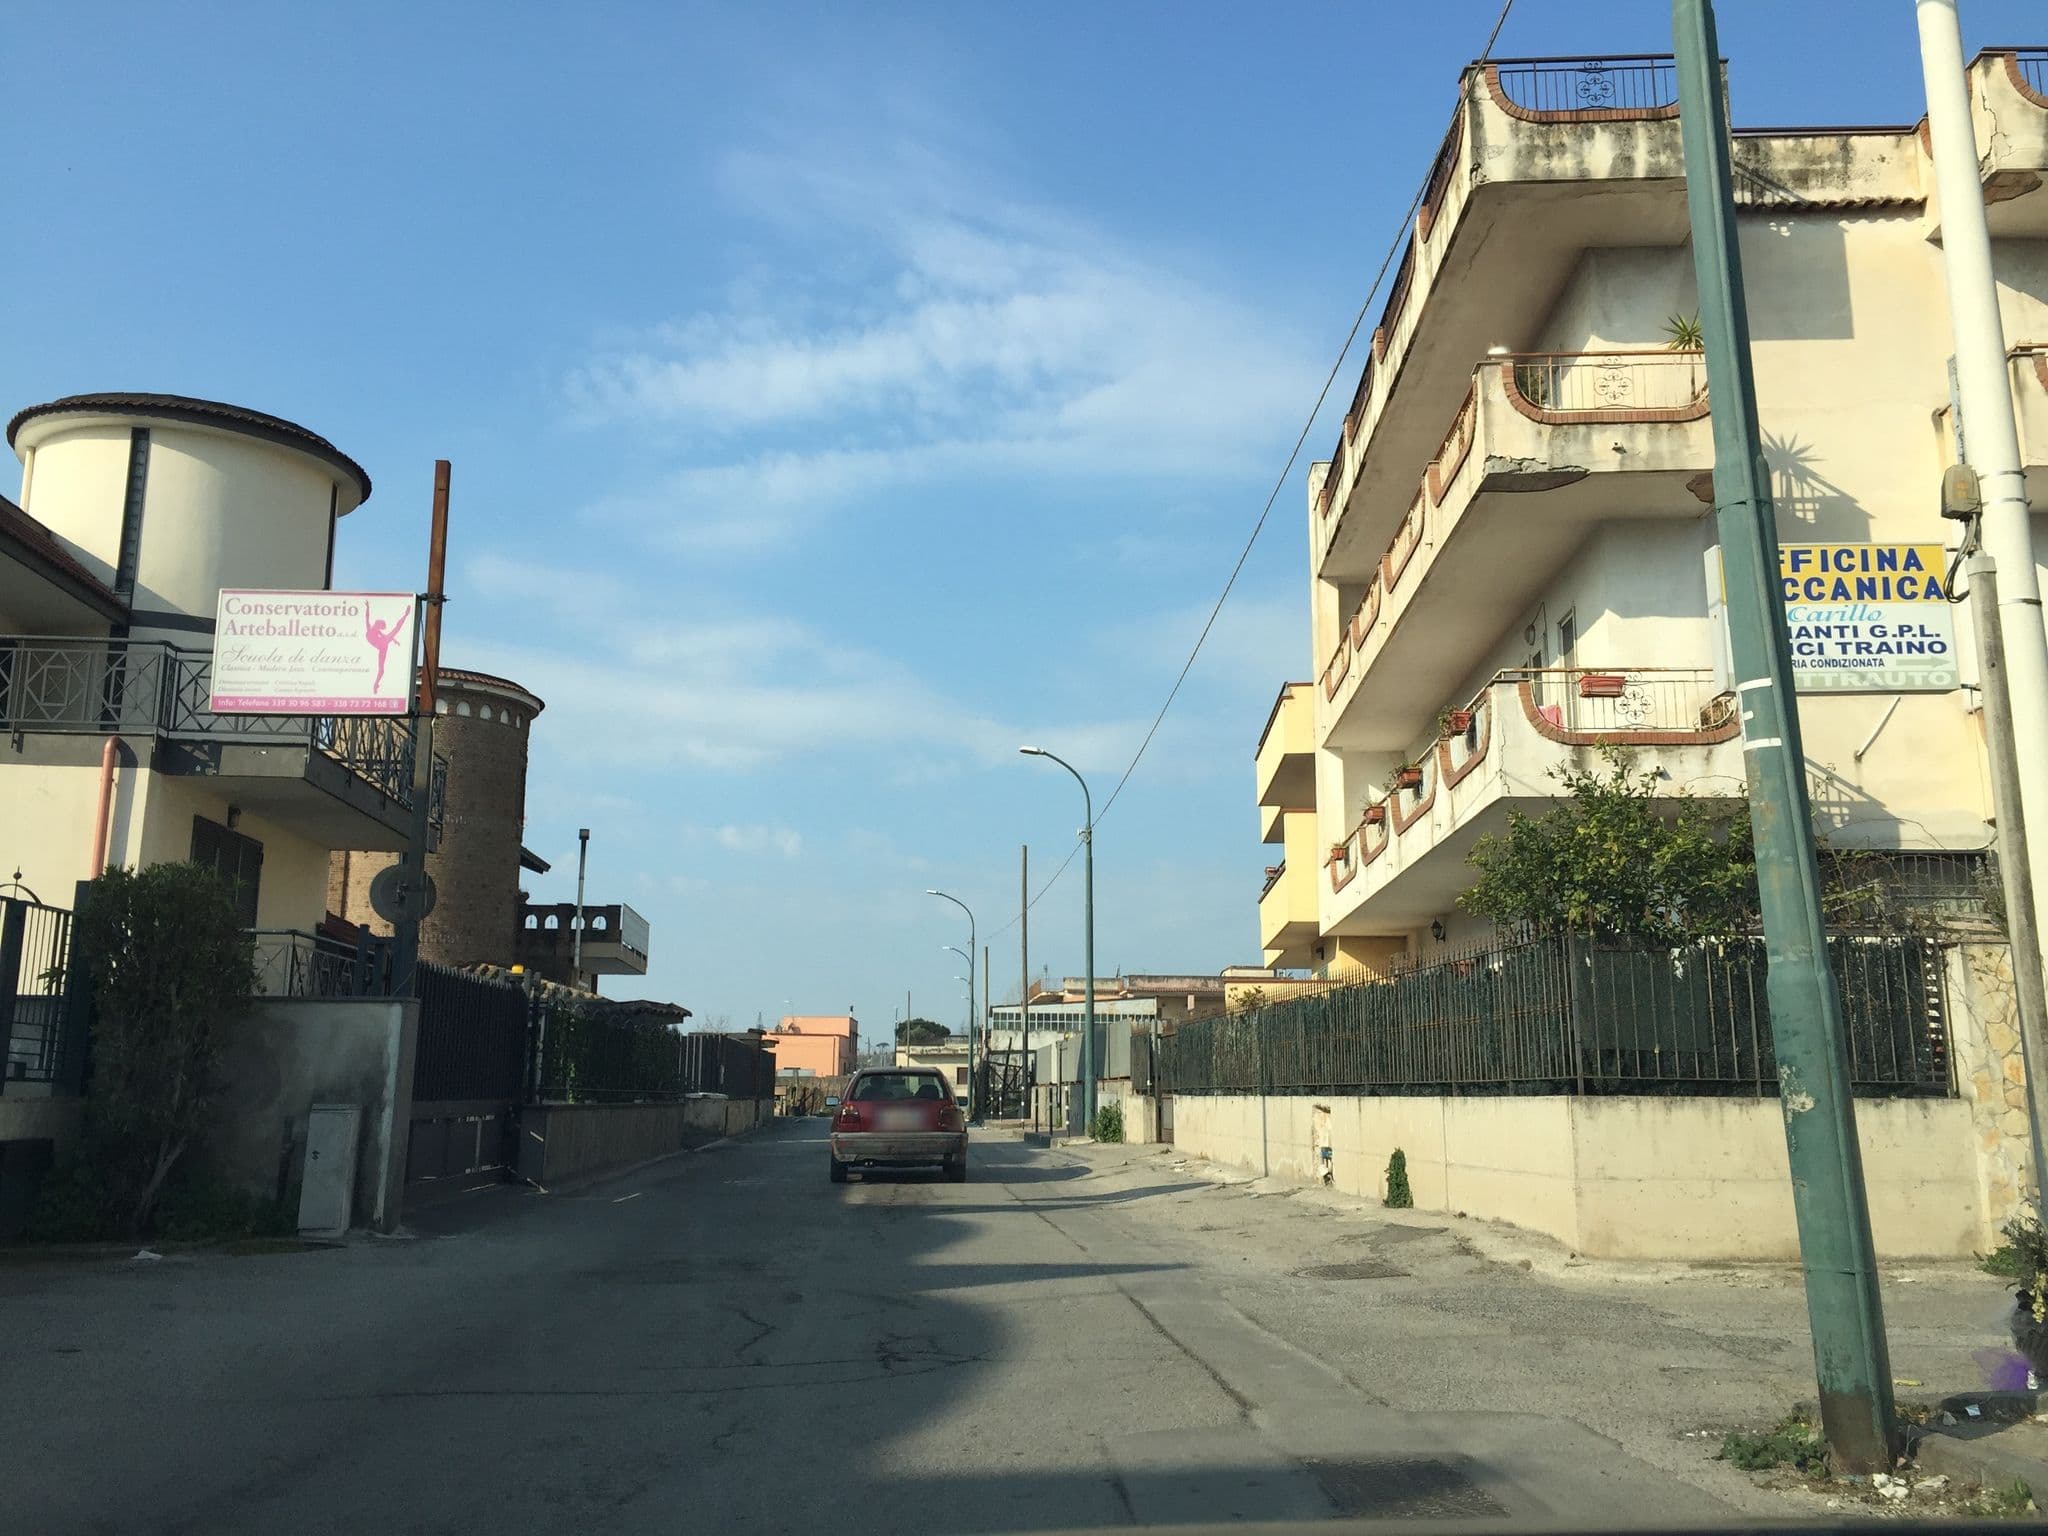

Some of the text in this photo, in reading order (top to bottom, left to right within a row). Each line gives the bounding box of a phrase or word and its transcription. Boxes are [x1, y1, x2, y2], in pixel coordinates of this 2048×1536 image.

[1778, 548, 1924, 573] FICINA
[1782, 575, 1947, 601] CCANICA
[225, 597, 359, 617] Conservatorio
[1787, 604, 1884, 622] Carillo
[223, 619, 337, 637] Arteballetto
[1786, 624, 1941, 639] IANTI G.P.L.
[221, 644, 362, 665] Scuola di danza
[1835, 641, 1947, 655] TRAINO
[1791, 658, 1885, 669] RIA CONDIZIONATA
[1796, 671, 1952, 688] TTRAUTO
